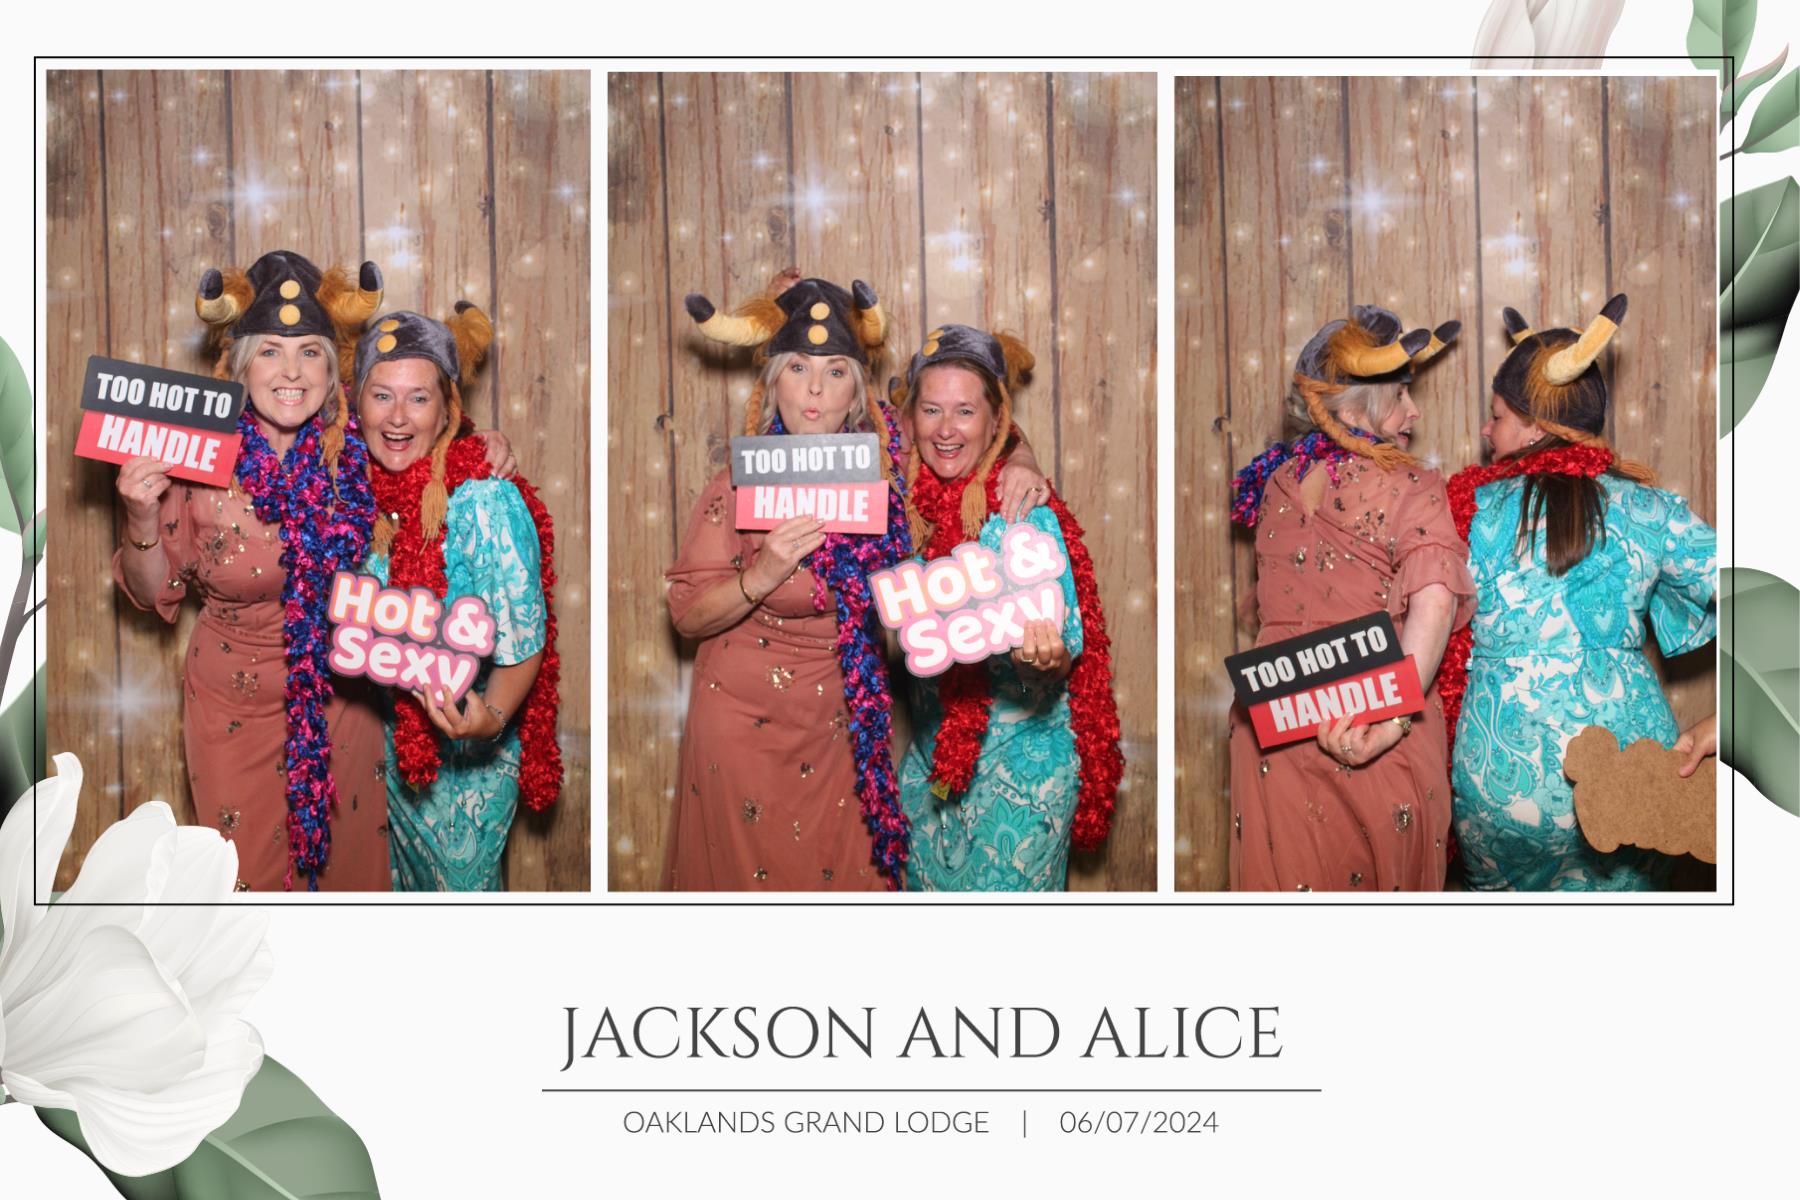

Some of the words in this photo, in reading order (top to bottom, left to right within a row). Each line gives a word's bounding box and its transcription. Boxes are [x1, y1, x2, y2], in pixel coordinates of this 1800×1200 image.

[97, 372, 146, 406] TOO
[148, 381, 199, 413] HOT
[202, 389, 232, 419] TO
[97, 413, 221, 473] HANDLE
[741, 448, 787, 475] TOO
[791, 446, 837, 472] HOT
[841, 444, 871, 470] TO
[753, 486, 869, 522] HANDLE
[878, 550, 996, 622] Hot
[1009, 531, 1057, 578] &
[333, 577, 435, 637] Hot
[447, 603, 488, 649] &
[334, 626, 471, 702] Sexy
[1240, 655, 1296, 693] TOO
[1296, 637, 1349, 676] HOT
[1350, 625, 1388, 658] TO
[1269, 671, 1402, 733] HANDLE
